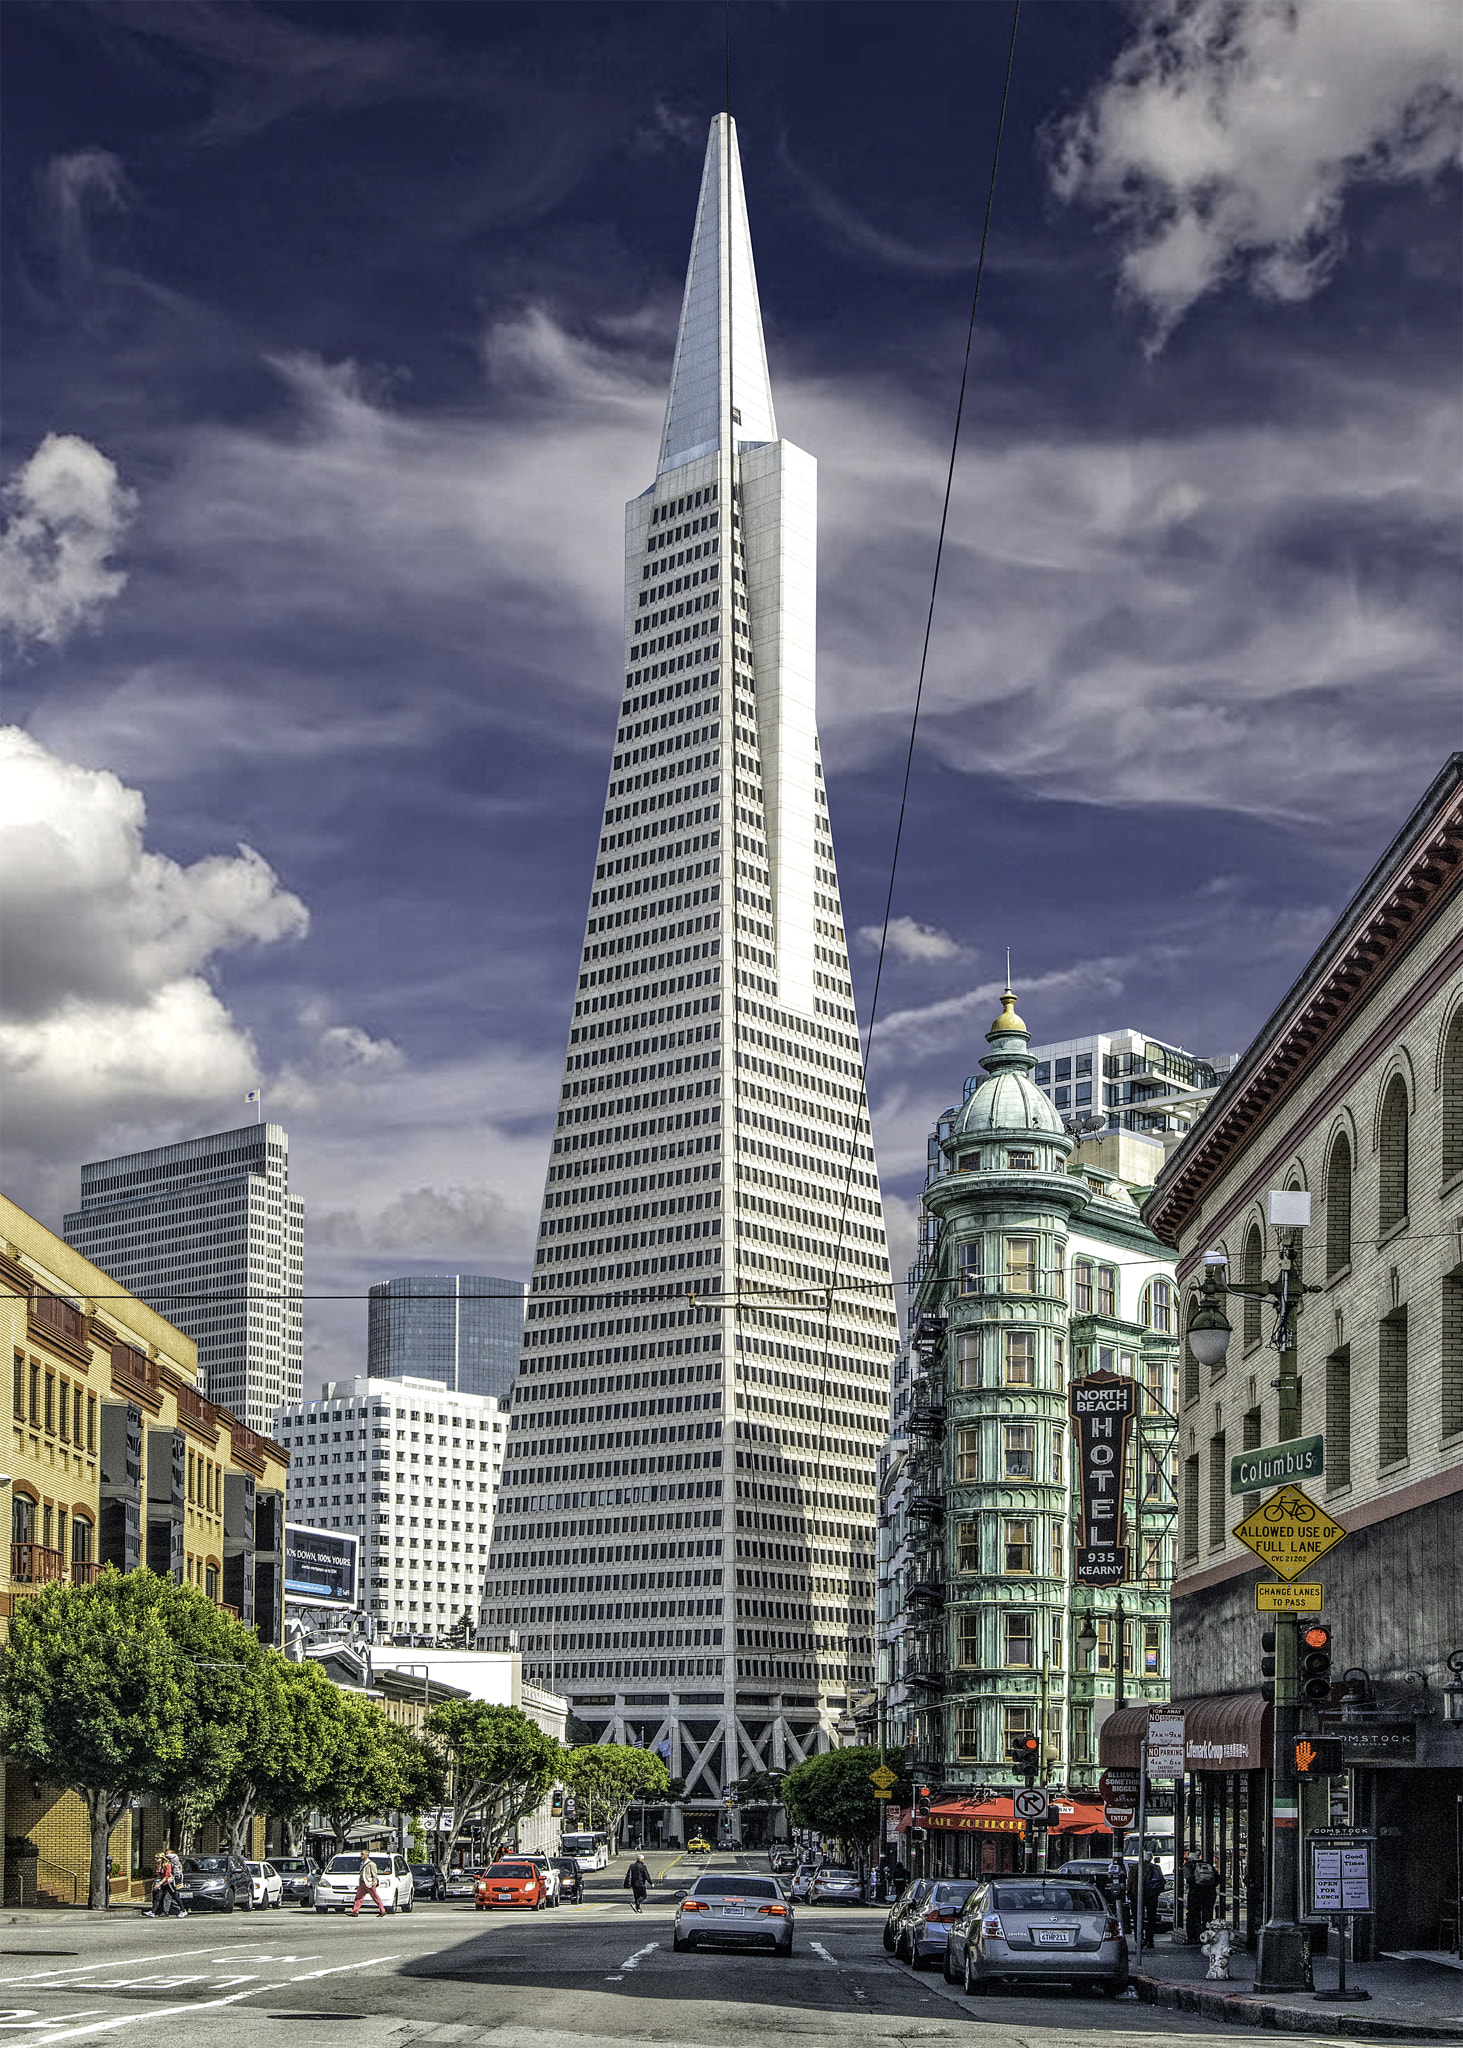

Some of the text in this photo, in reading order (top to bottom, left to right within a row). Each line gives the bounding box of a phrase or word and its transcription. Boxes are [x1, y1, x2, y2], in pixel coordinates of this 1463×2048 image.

[1076, 1389, 1128, 1401] NORTH
[1076, 1401, 1127, 1412] BEACH
[1240, 1451, 1313, 1484] Columbus
[1089, 1417, 1115, 1546] HOTEL
[1240, 1526, 1338, 1538] ALLOWED USE OF
[1256, 1541, 1322, 1552] FULL LANE
[286, 1547, 352, 1567] 10% DOWN, 100% YOURS.
[1087, 1552, 1115, 1563] 935
[1078, 1565, 1124, 1575] KEARNY
[1259, 1587, 1320, 1596] CHANGE LANES
[1273, 1598, 1306, 1607] TO PASS
[1149, 1713, 1160, 1722] NO
[1148, 1747, 1159, 1757] NO
[1207, 1740, 1223, 1764] Group
[928, 1817, 1026, 1830] CAFE ZOETROPE
[211, 1955, 323, 1963] NO
[8, 1975, 260, 1989] LEFT
